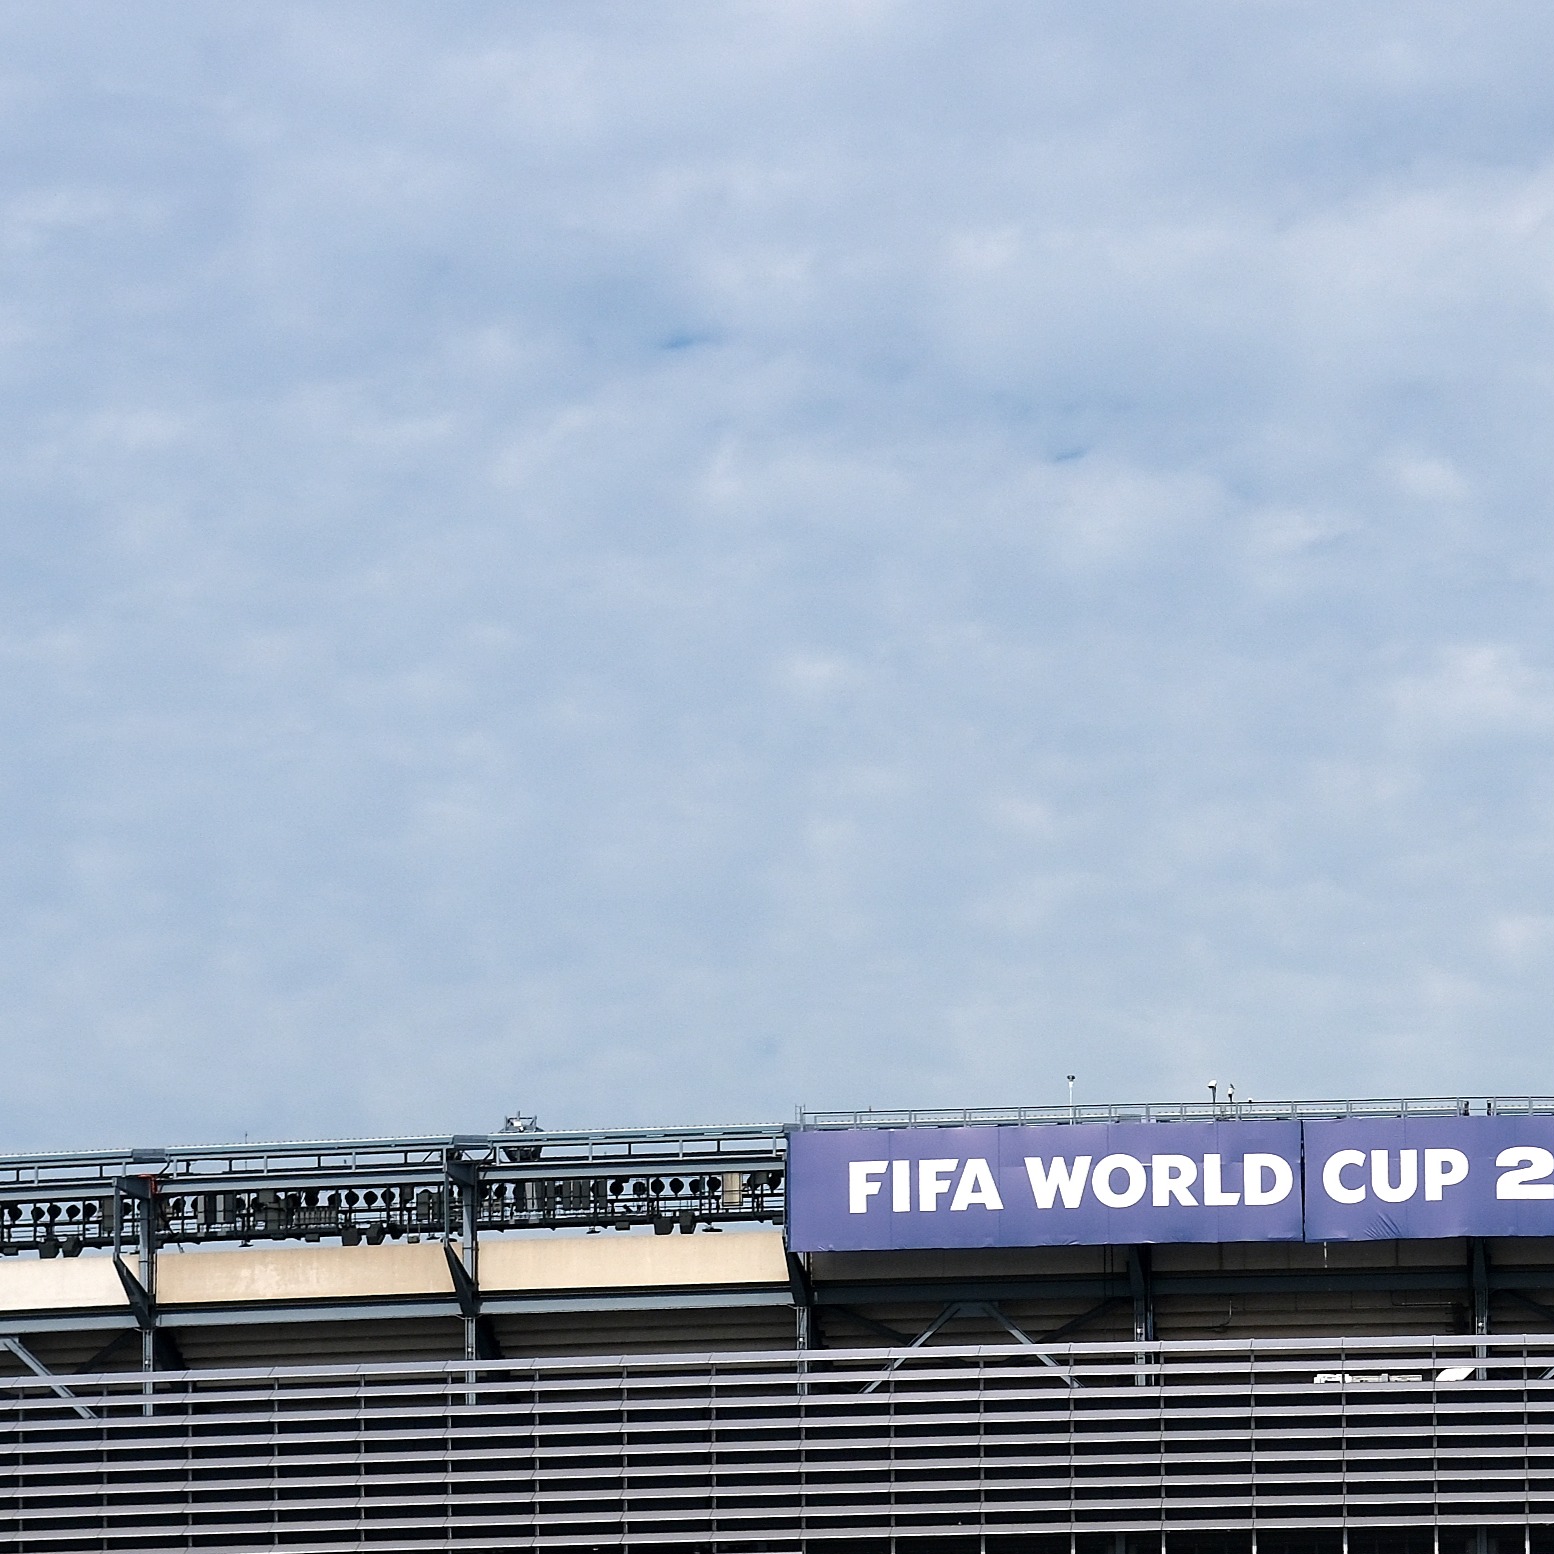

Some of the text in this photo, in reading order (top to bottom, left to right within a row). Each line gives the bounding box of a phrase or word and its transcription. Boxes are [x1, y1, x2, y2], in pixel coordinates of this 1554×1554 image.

[848, 1157, 1005, 1214] FIFA
[1023, 1152, 1294, 1209] WORLD
[1322, 1148, 1470, 1204] CUP
